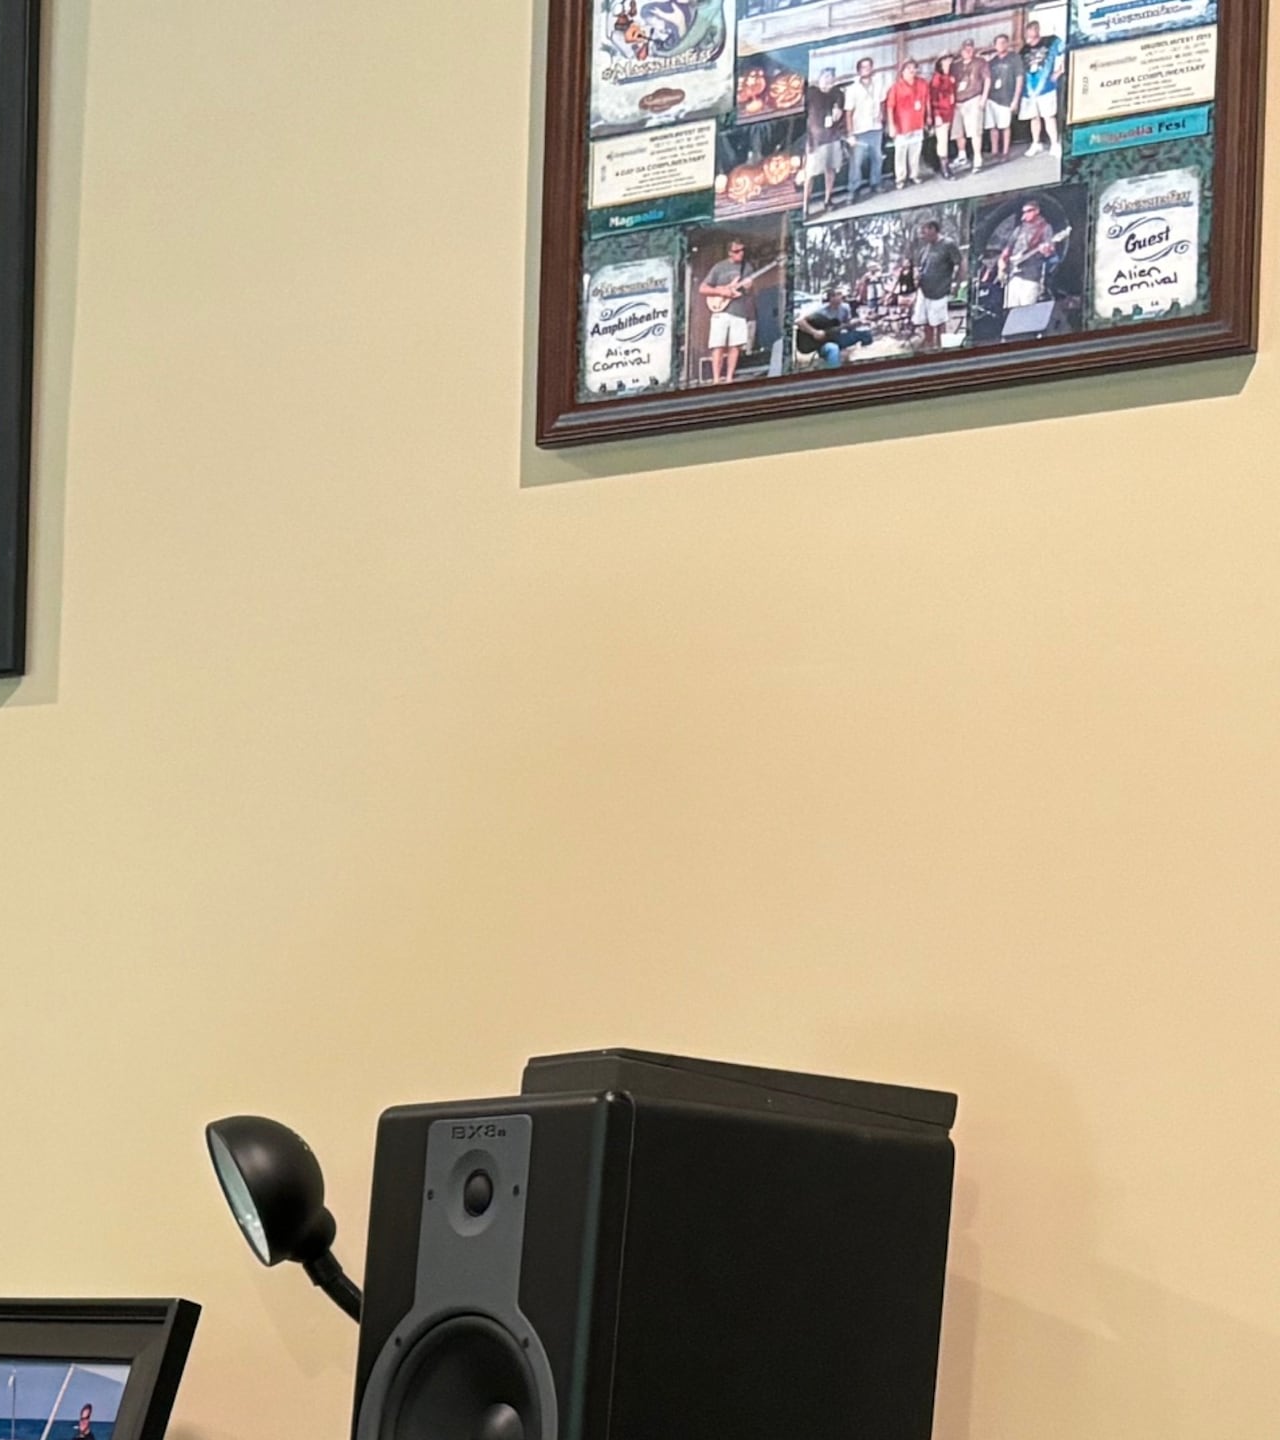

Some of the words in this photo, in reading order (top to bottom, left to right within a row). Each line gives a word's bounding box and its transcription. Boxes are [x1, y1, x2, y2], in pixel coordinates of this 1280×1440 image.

[1157, 119, 1186, 132] Fest
[1124, 226, 1171, 254] Guest
[1107, 272, 1178, 295] Carnival
[1114, 266, 1161, 283] Alien
[590, 308, 669, 337] Amphitheatre
[592, 353, 650, 372] Carnival
[605, 347, 641, 359] Alien
